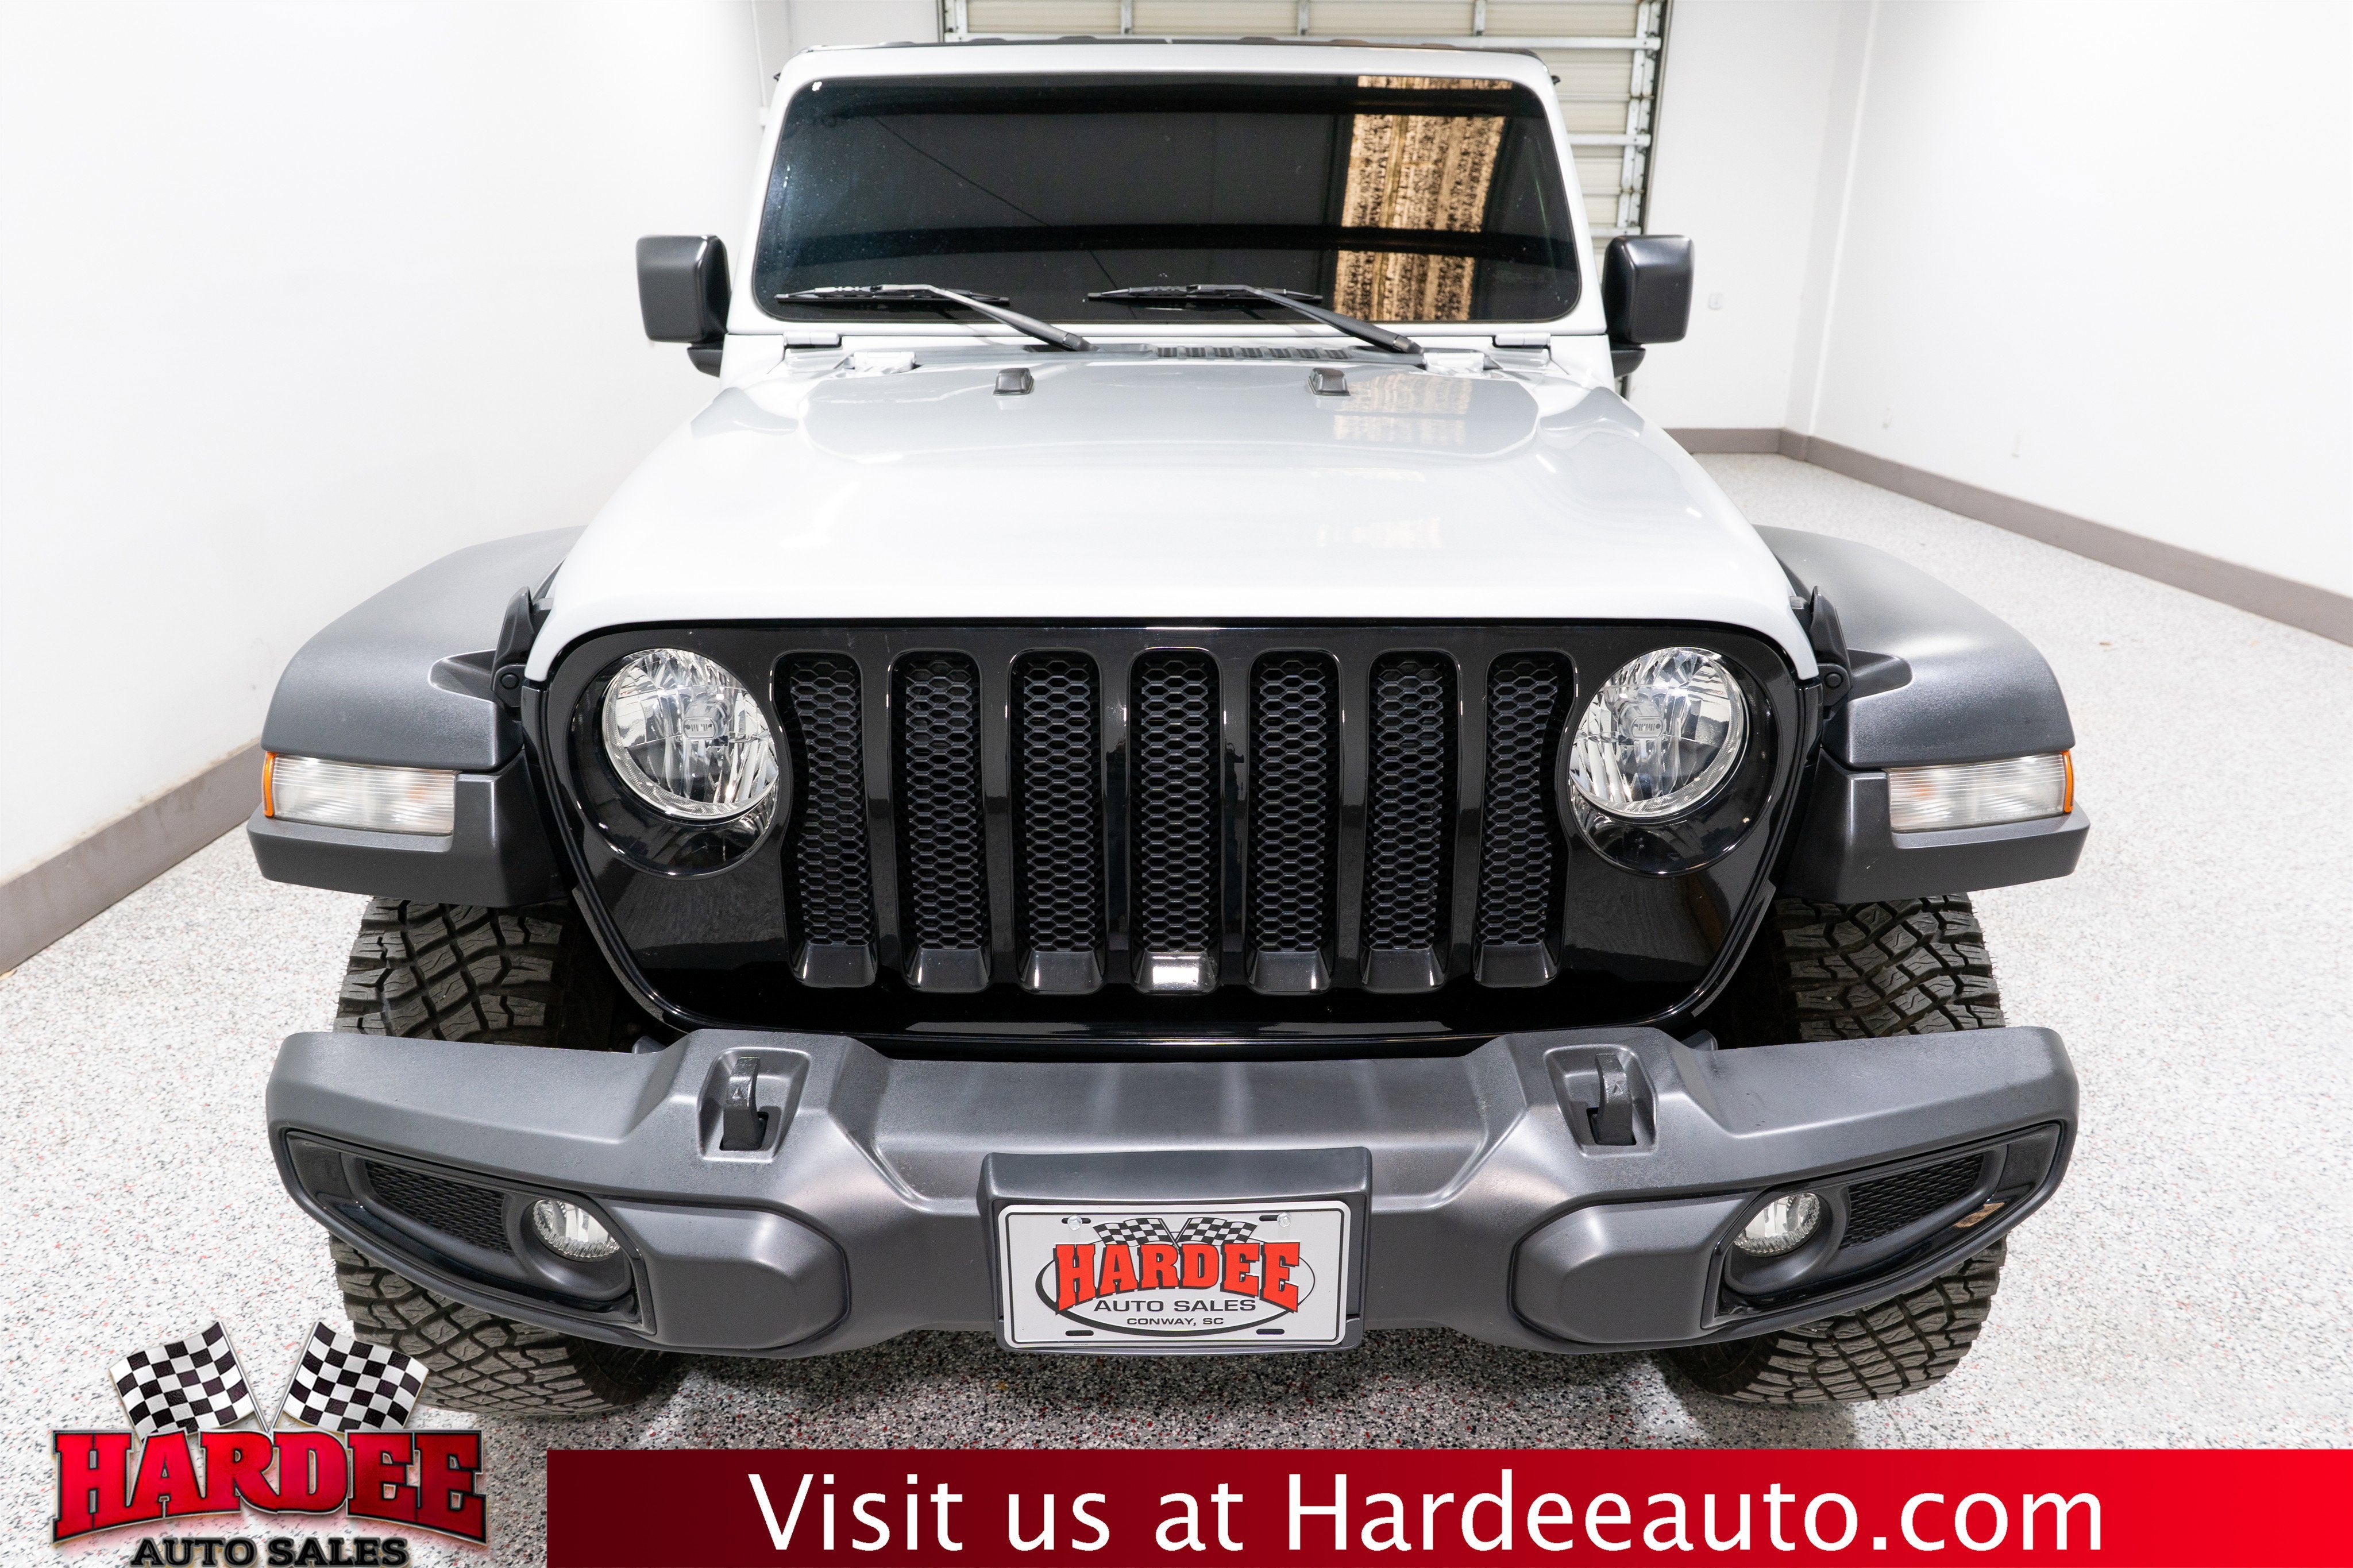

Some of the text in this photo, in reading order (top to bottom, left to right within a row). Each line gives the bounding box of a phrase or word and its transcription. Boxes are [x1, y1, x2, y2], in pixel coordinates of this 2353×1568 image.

[1053, 1242, 1300, 1315] HARDEE
[1093, 1299, 1256, 1312] AUTO SALES
[1127, 1317, 1224, 1326] CONWAY, SC
